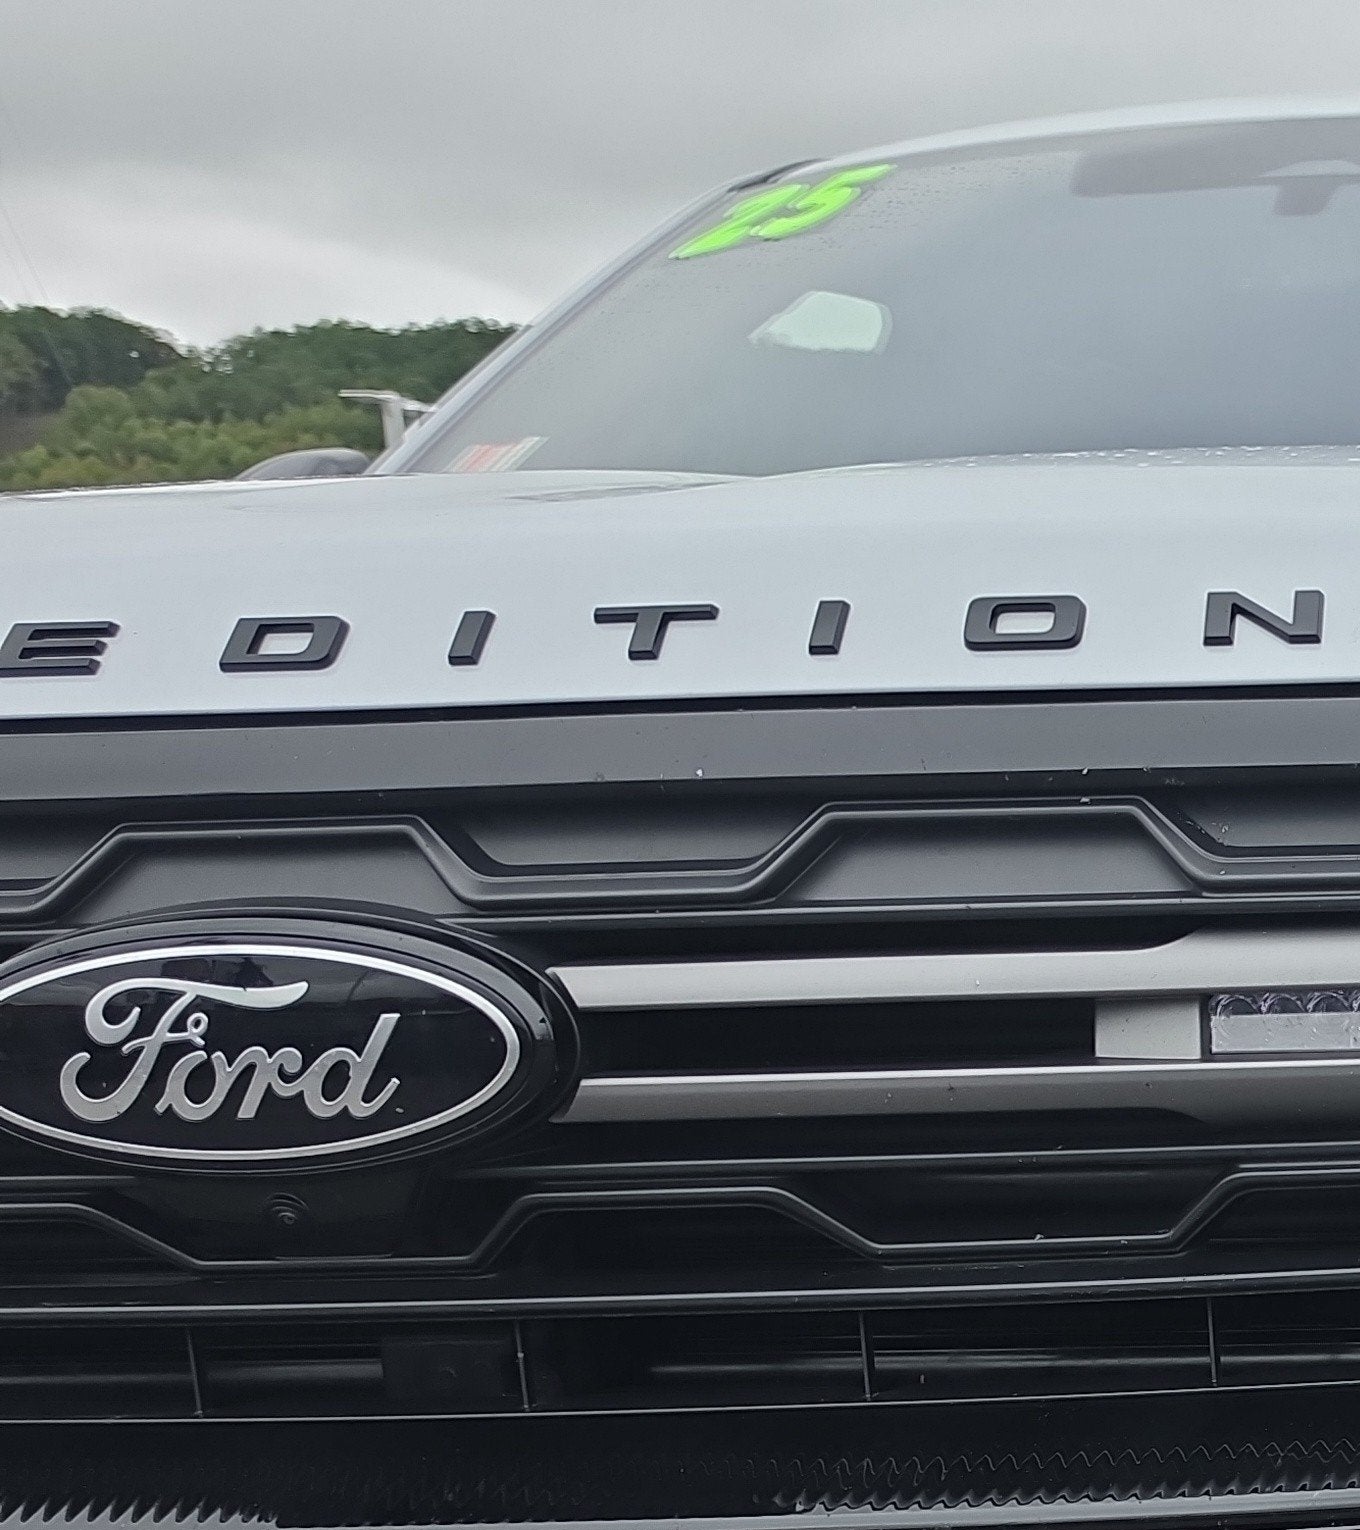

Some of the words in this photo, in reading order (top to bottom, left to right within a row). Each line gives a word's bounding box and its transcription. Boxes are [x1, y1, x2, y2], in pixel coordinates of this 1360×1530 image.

[668, 163, 898, 259] 25
[0, 589, 1325, 677] EDITION
[59, 977, 401, 1122] Ford
